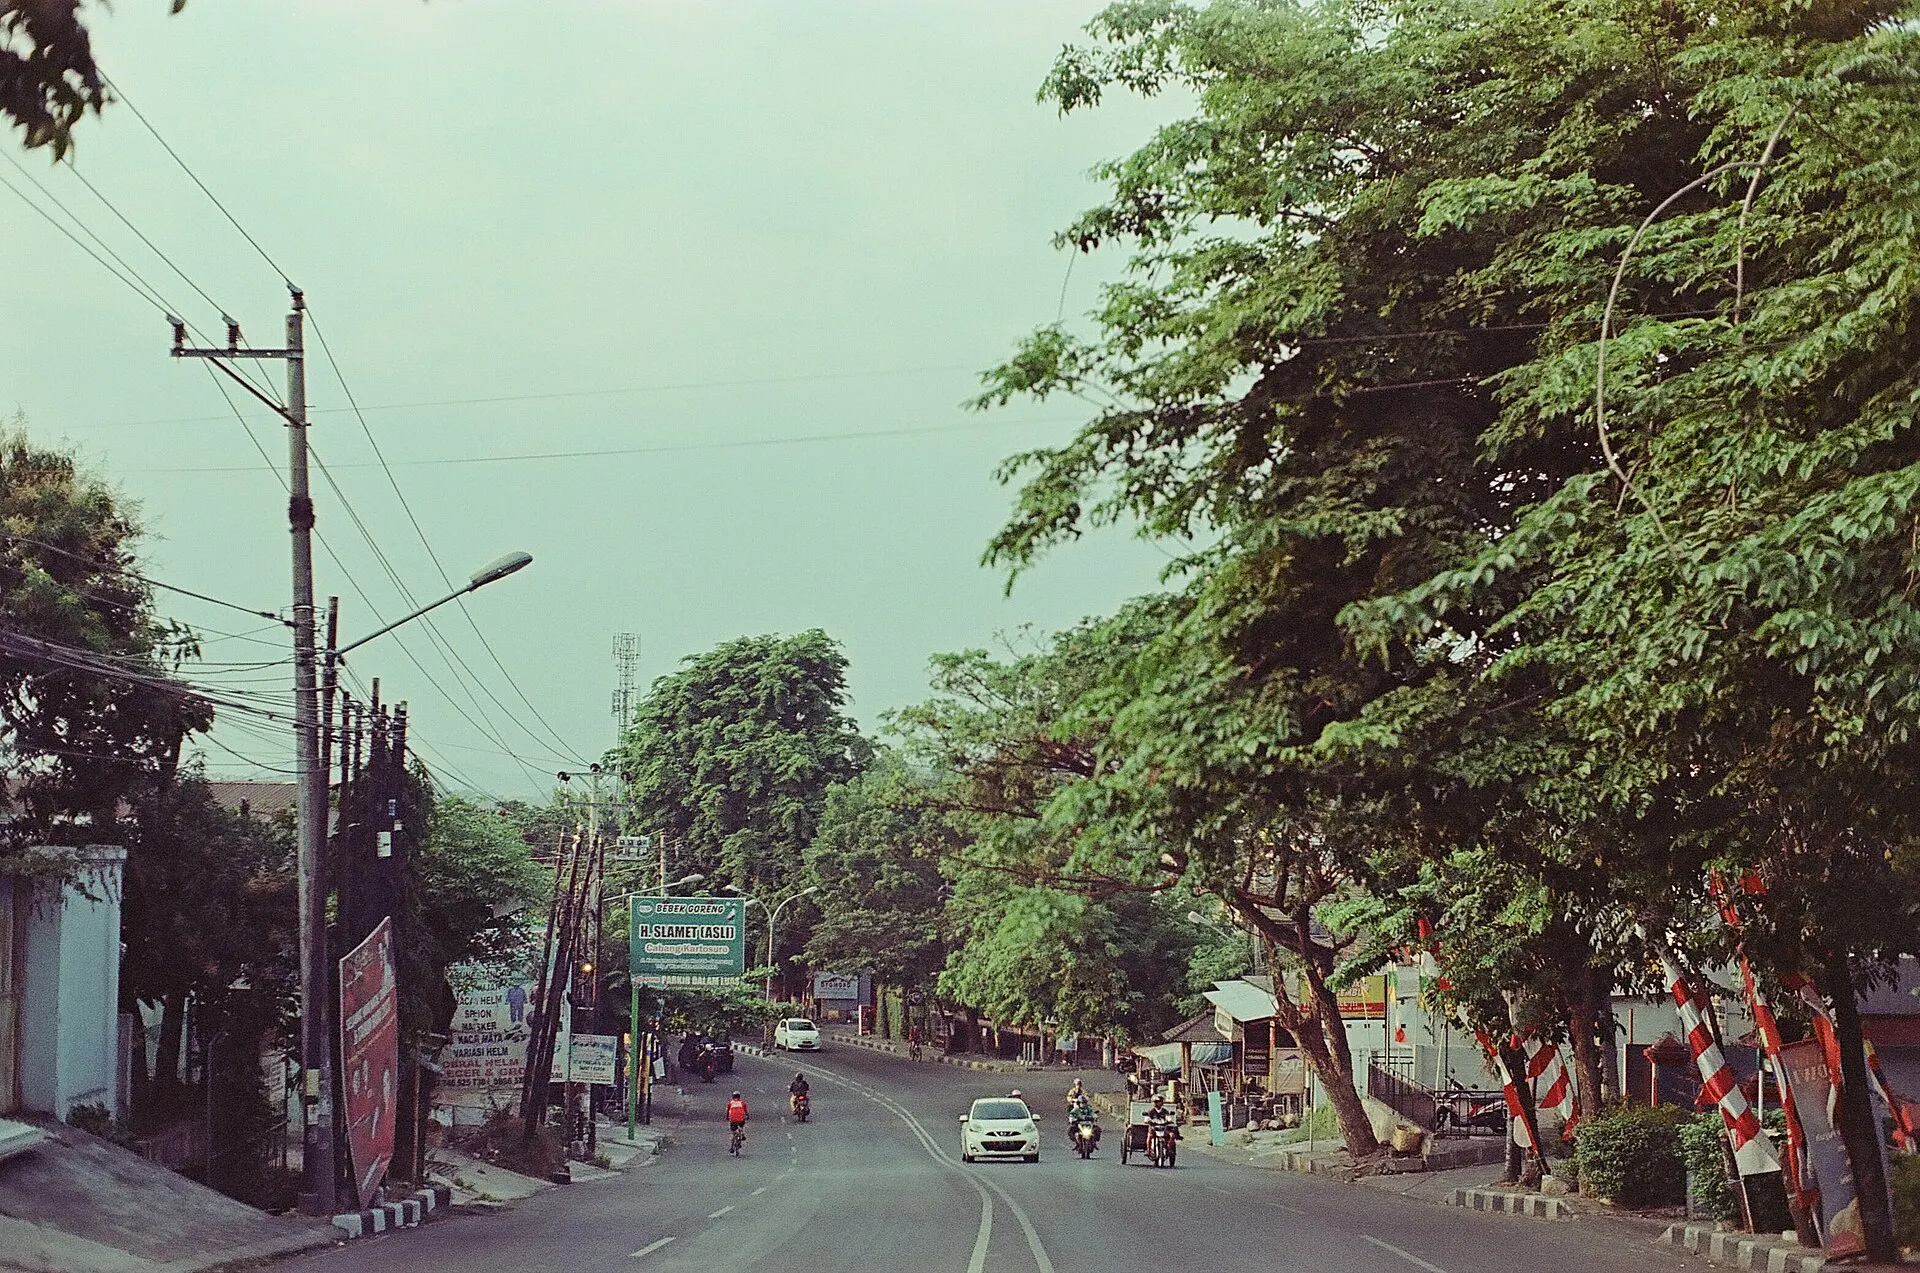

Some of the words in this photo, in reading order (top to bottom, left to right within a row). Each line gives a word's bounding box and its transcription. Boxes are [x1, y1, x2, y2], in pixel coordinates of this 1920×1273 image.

[656, 903, 686, 914] BEBEK
[687, 904, 725, 915] GORENG
[639, 924, 651, 938] H.
[653, 924, 698, 939] SLAMET
[699, 925, 735, 940] (ASLI)
[645, 943, 682, 955] Cabang
[682, 943, 729, 954] Kartosuro
[453, 1048, 485, 1059] VARIASI
[486, 1047, 509, 1057] HELM
